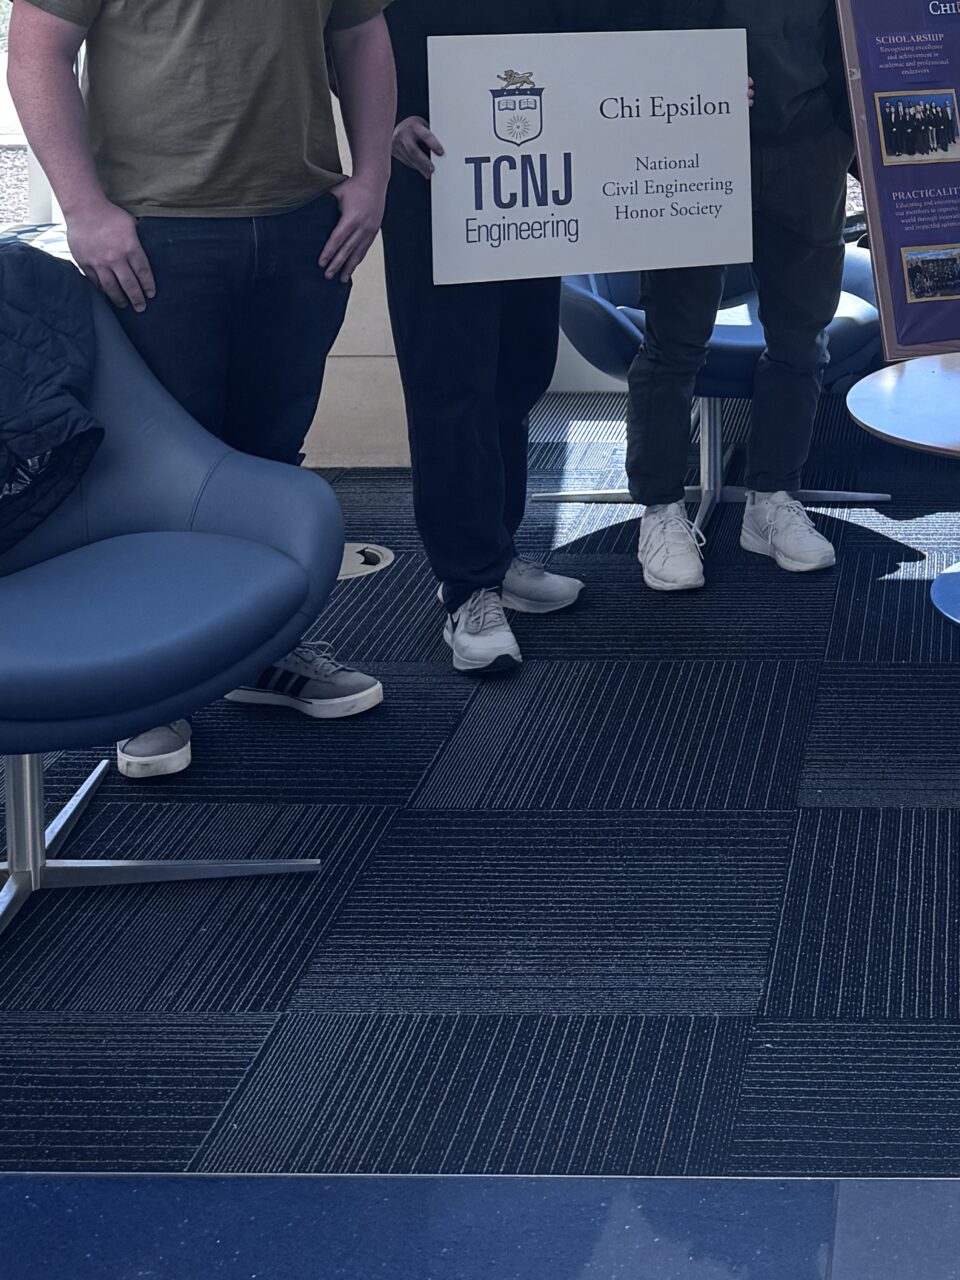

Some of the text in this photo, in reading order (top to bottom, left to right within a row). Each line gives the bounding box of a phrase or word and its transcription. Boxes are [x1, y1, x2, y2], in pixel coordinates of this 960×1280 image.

[875, 33, 945, 45] SCHOLARSHIP
[599, 94, 731, 124] Chi Epsilon
[635, 153, 700, 172] National
[464, 151, 573, 211] TCNJ
[602, 177, 733, 200] Civil Engineering
[615, 200, 722, 220] Honor Society
[465, 213, 579, 248] Engineering
